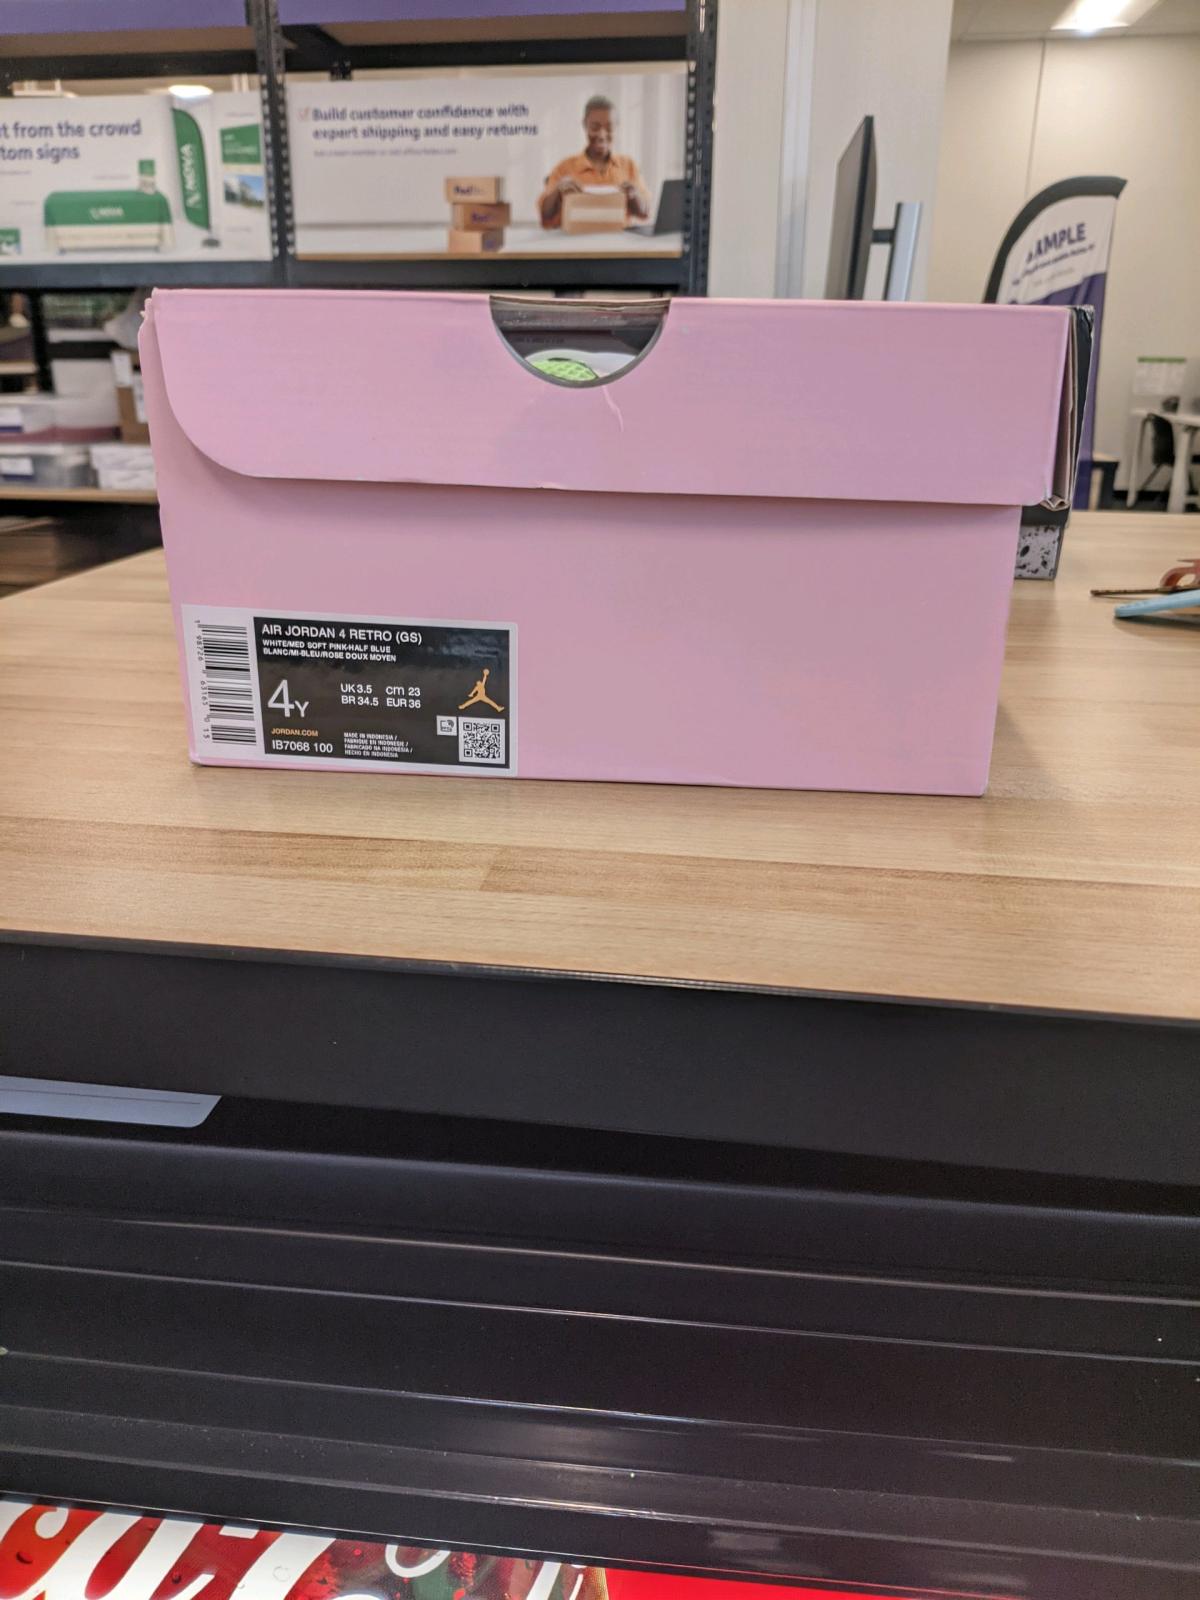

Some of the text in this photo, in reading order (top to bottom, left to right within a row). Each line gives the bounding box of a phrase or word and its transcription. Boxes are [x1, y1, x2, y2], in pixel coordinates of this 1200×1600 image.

[312, 103, 529, 121] Build customer confidence with
[13, 121, 53, 138] from
[57, 121, 85, 138] the
[89, 118, 142, 137] crowd
[312, 123, 538, 142] expert shipping and easy returns
[36, 143, 80, 164] signs
[262, 623, 423, 646] AIR JORDAN 4 RETRO (GS)
[262, 639, 305, 649] WHITE/MED
[307, 641, 327, 650] SOFT
[371, 645, 392, 654] BLUE
[345, 652, 368, 661] DOUX
[370, 653, 397, 663] MOYEN
[340, 683, 421, 697] UK 3.5 cm 23
[341, 695, 421, 709] BR 34.5 EUR 36
[271, 727, 319, 738] JORDAN.COM
[272, 739, 334, 754] IB7068 100
